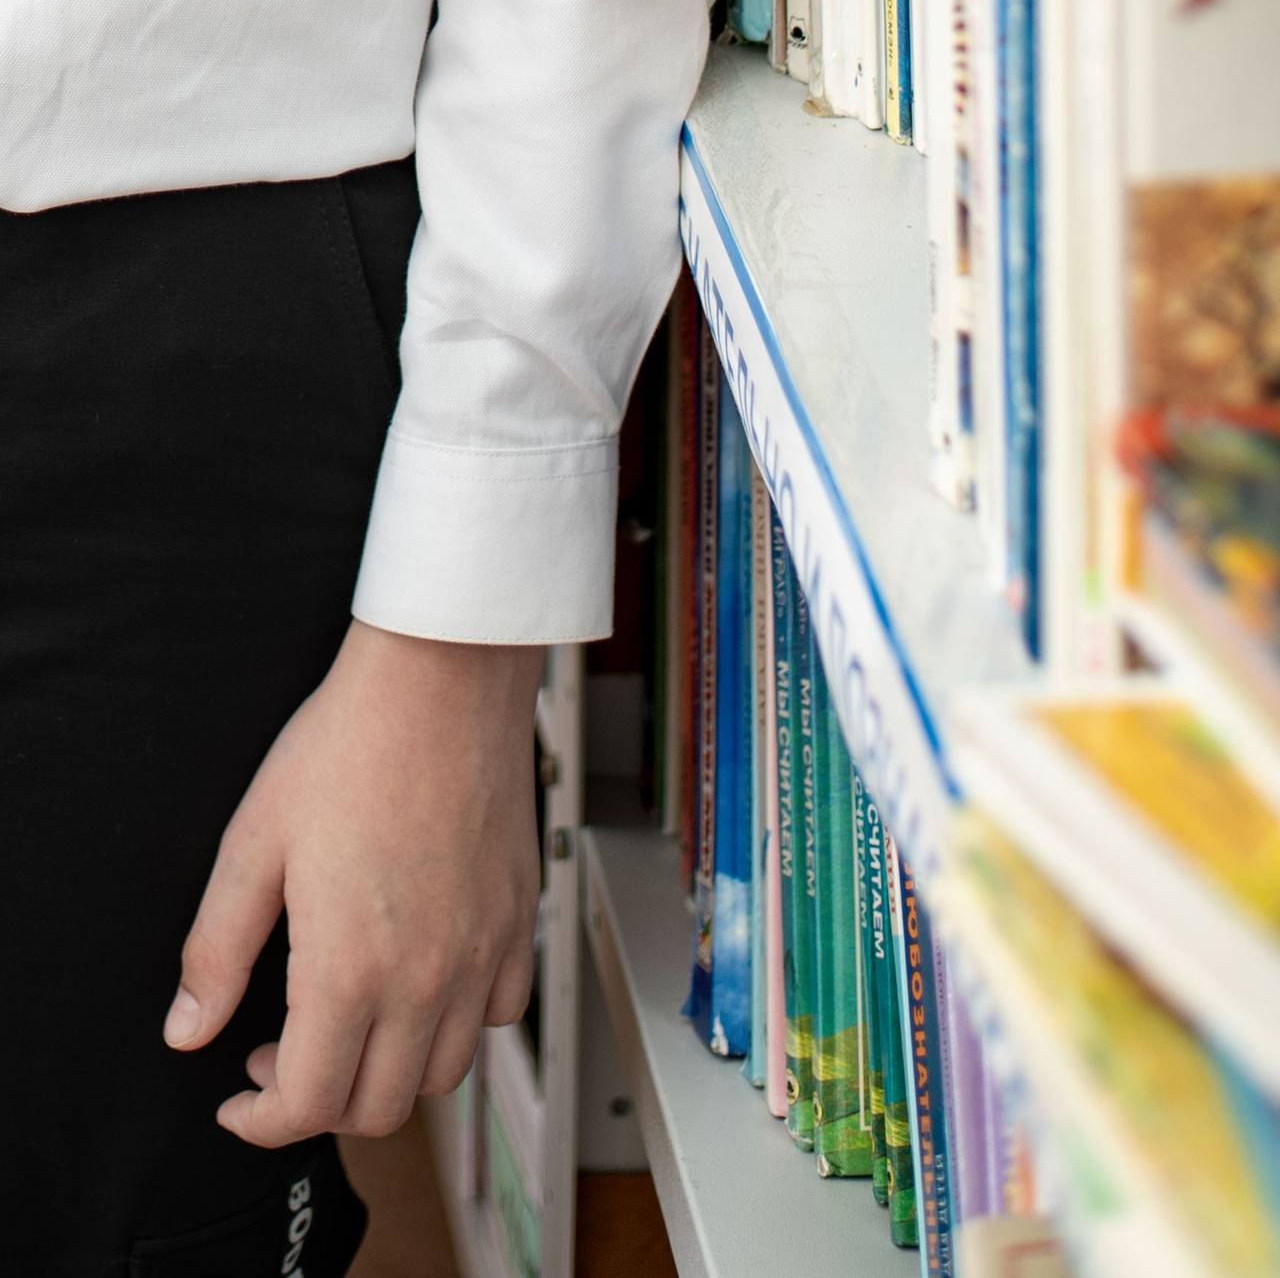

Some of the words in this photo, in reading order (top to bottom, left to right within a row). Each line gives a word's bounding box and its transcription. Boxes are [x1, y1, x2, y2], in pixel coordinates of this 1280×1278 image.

[776, 660, 790, 719] МЫ
[800, 677, 812, 736] МЫ
[777, 724, 793, 877] СЧИТАЕМ
[801, 742, 817, 898] СЧИТАЕМ
[853, 776, 868, 930] СЧИТАЕМ
[866, 801, 886, 960] СЧИТАЕМ
